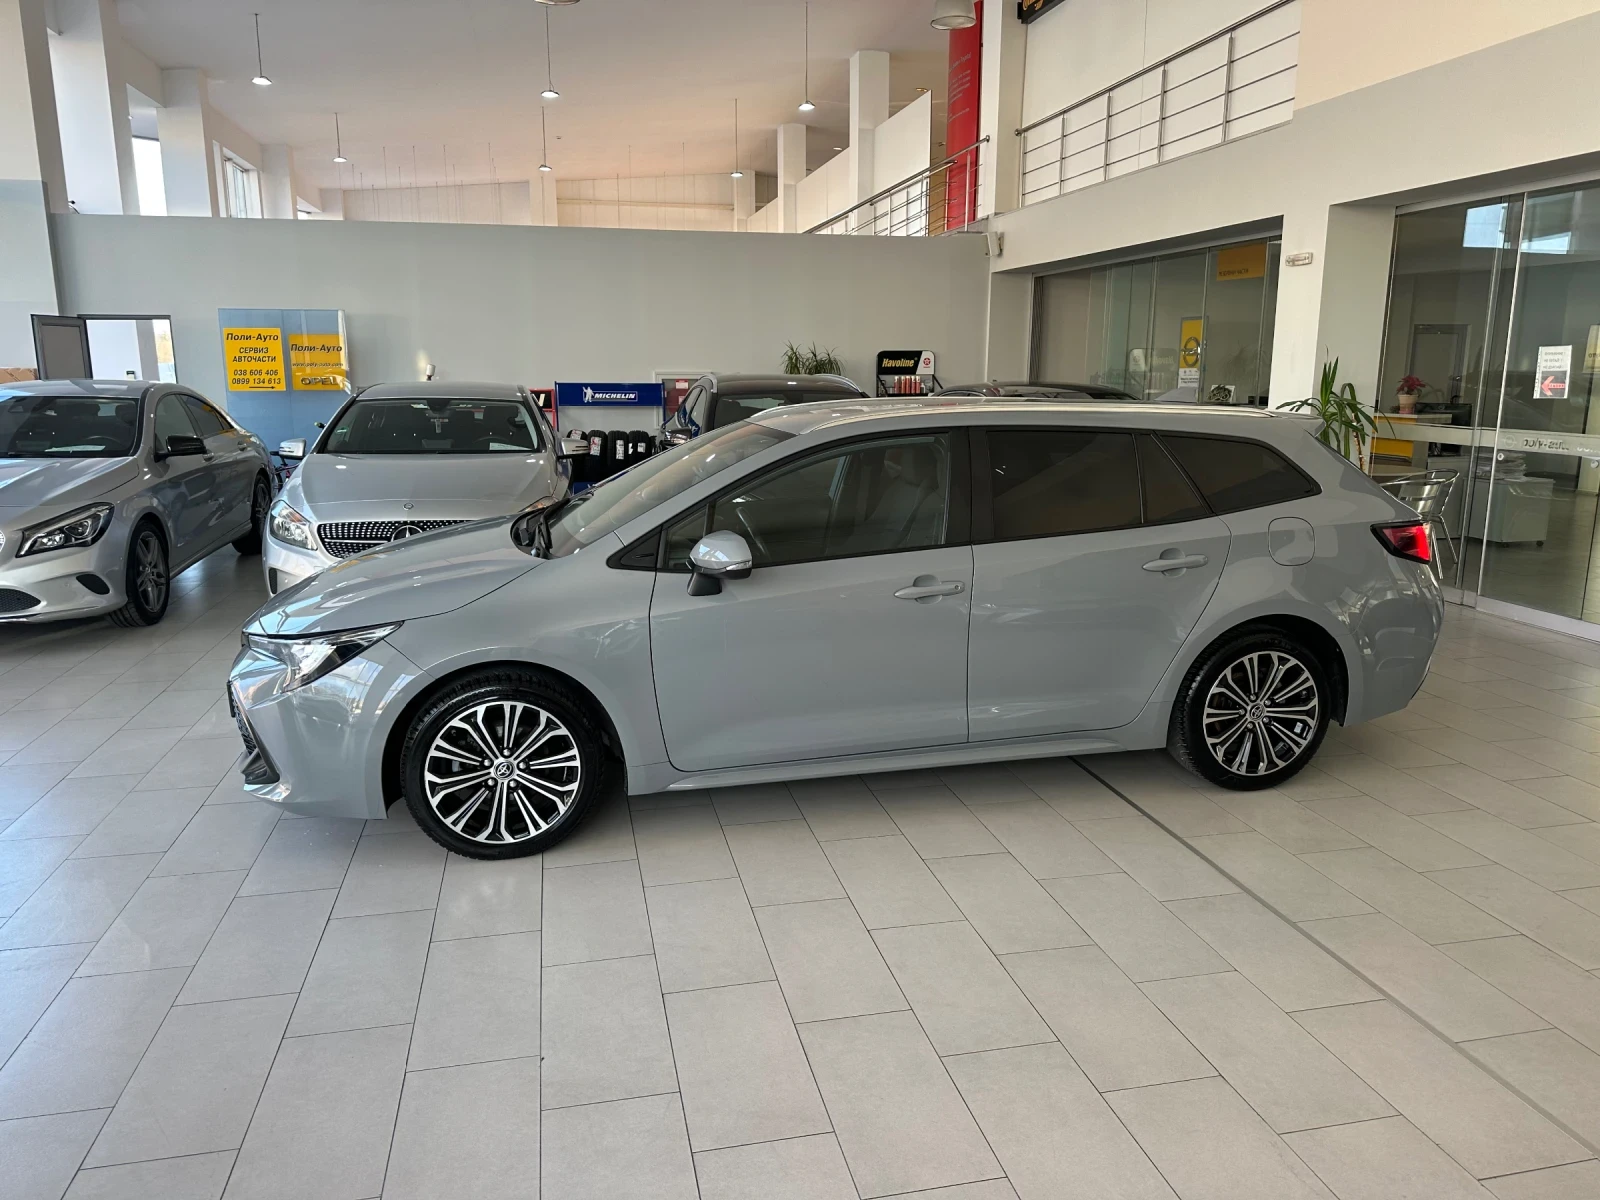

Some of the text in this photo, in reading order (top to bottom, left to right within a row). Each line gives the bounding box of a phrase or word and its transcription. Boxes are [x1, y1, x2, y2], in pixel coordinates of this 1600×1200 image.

[226, 333, 279, 342] Поли-Ауто
[290, 344, 343, 353] Поли-Ауто
[232, 355, 277, 363] АВТОЧАСТИ
[882, 358, 914, 367] Havoline
[231, 377, 282, 385] 0899 134 613
[300, 376, 339, 386] OPEL
